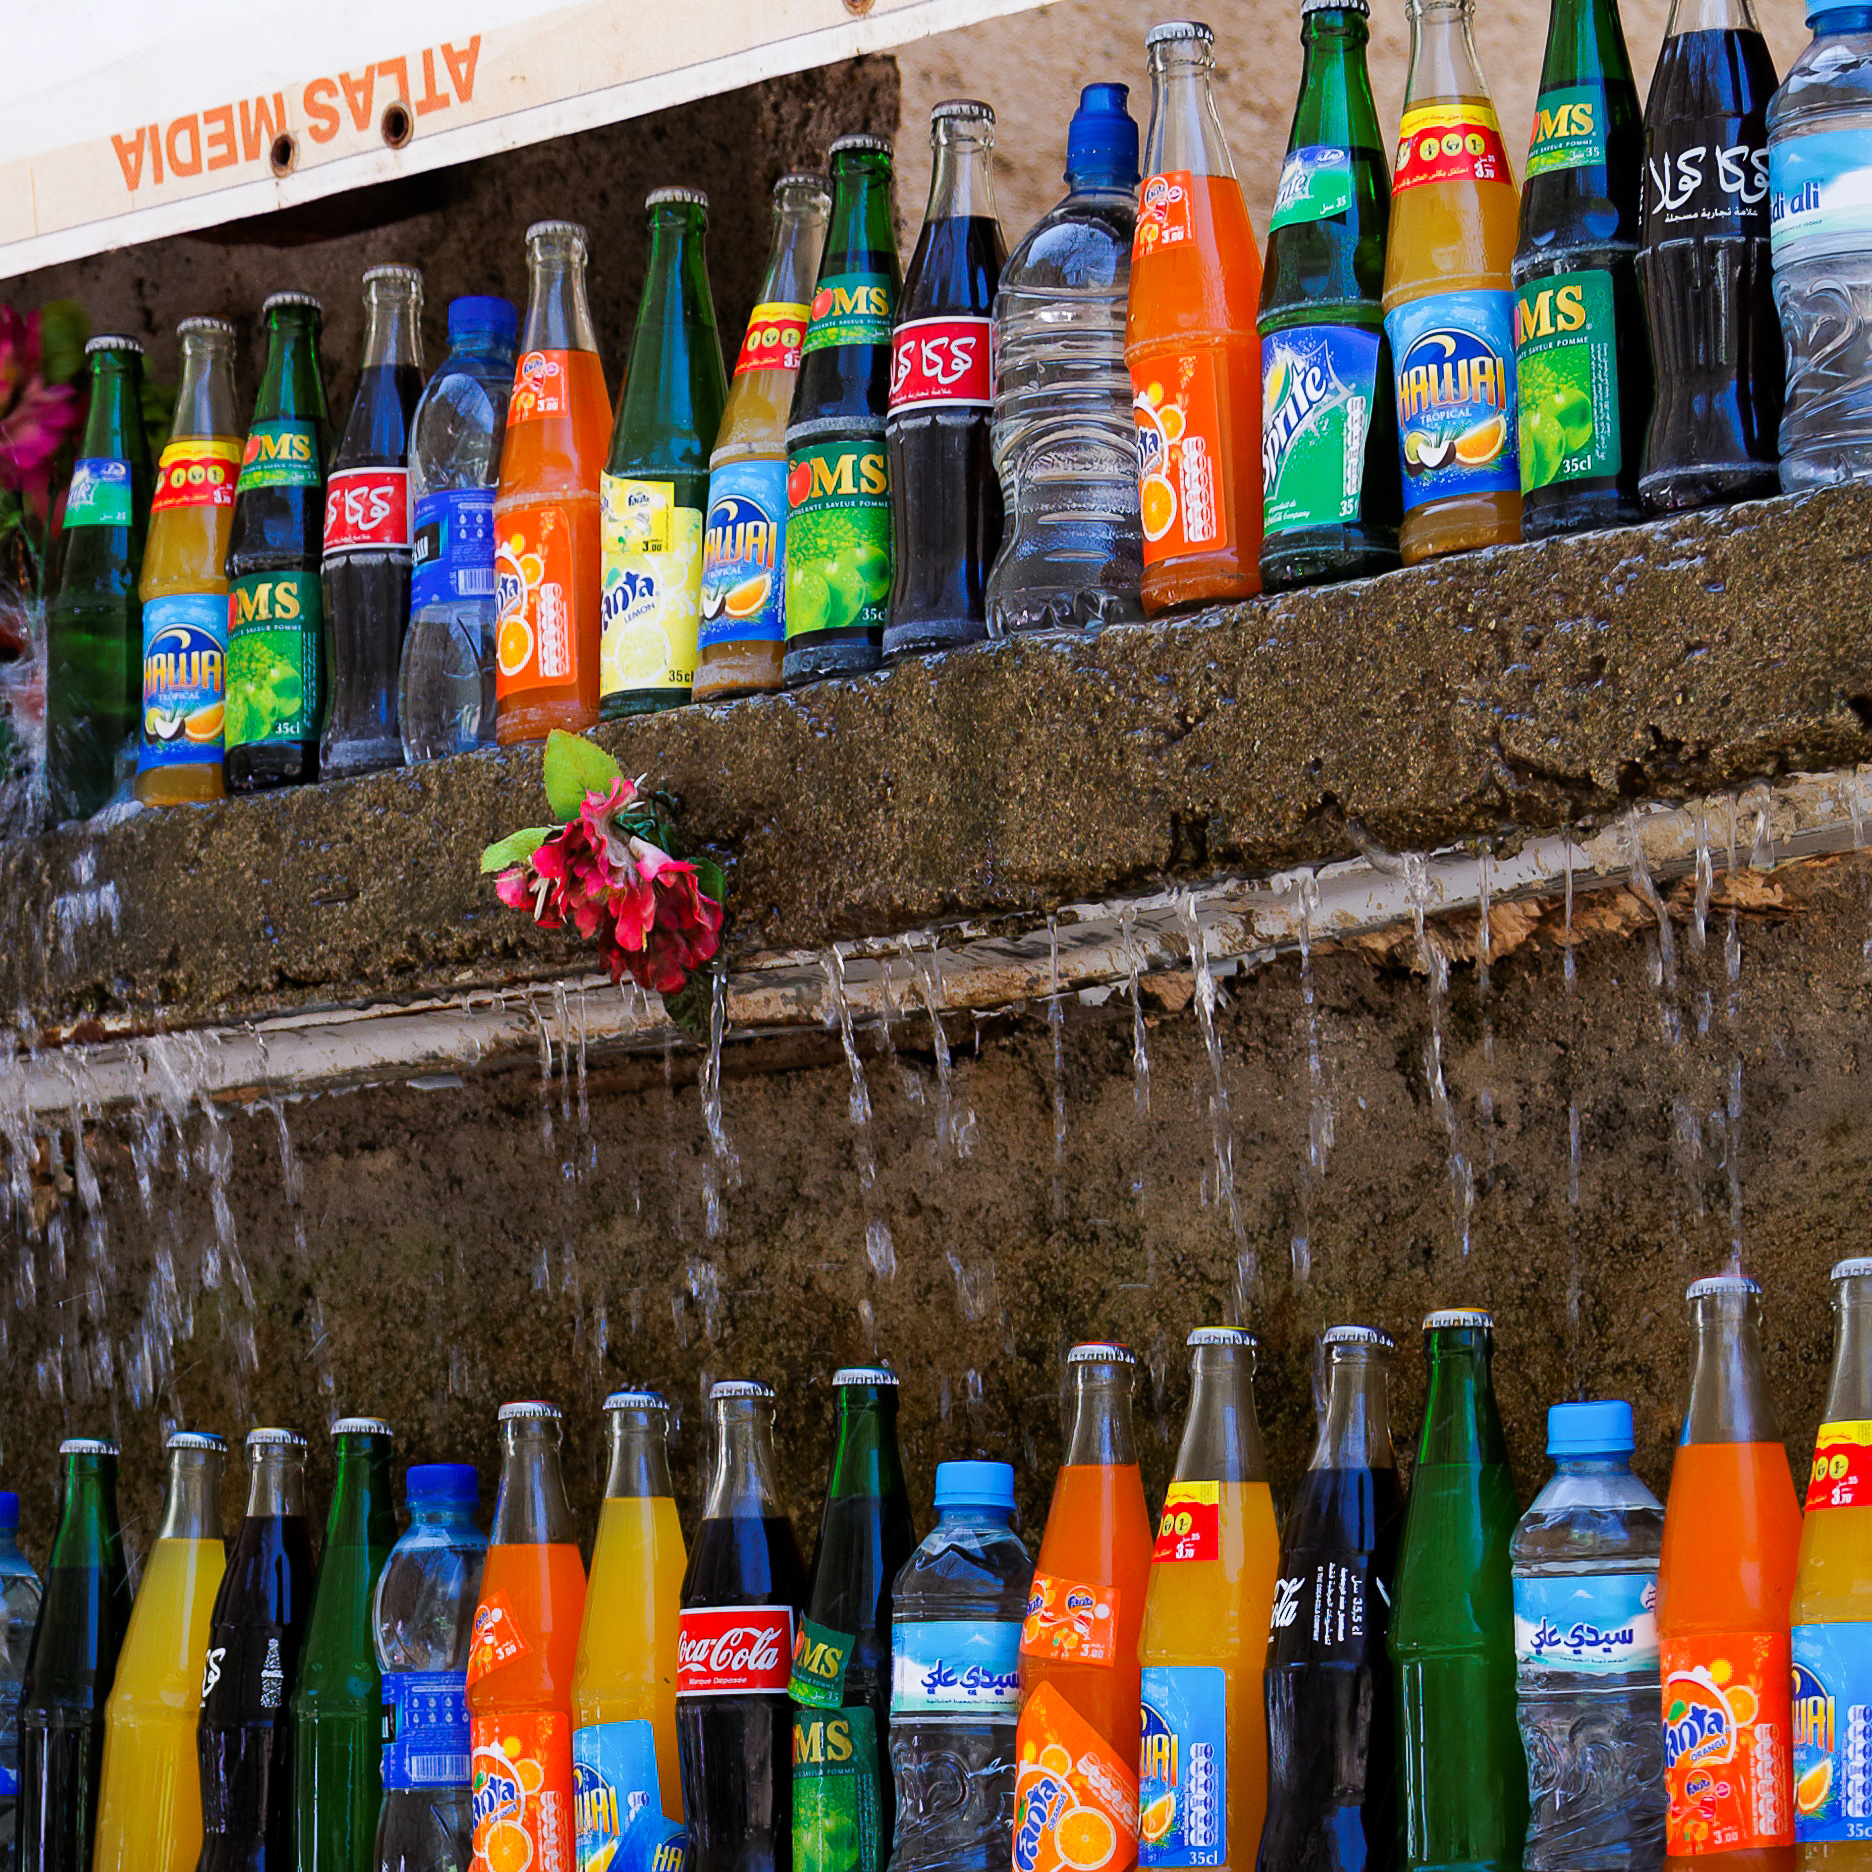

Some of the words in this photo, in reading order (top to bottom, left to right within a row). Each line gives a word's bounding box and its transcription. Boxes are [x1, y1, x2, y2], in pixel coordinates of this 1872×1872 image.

[303, 34, 482, 144] ATLAS
[111, 92, 290, 191] MEDIA
[1649, 149, 1707, 216] كولا
[1789, 181, 1820, 215] ali
[1528, 343, 1554, 356] SAVEUR
[1556, 336, 1589, 348] POMME
[1397, 356, 1507, 429] HAWAI
[1420, 407, 1472, 425] TROPICAL
[1563, 455, 1592, 474] 35cl
[703, 521, 778, 571] AWAI
[601, 570, 655, 632] anta
[624, 603, 657, 625] LEMON
[274, 721, 301, 736] 35cl
[677, 1627, 783, 1674] Coca-Cola
[1530, 1617, 1562, 1658] علي
[1563, 1622, 1634, 1655] سيدي
[921, 1658, 958, 1695] علي
[1693, 1738, 1729, 1761] ORANGE
[1015, 1778, 1058, 1871] Fanta
[1189, 1849, 1219, 1865] 35cl
